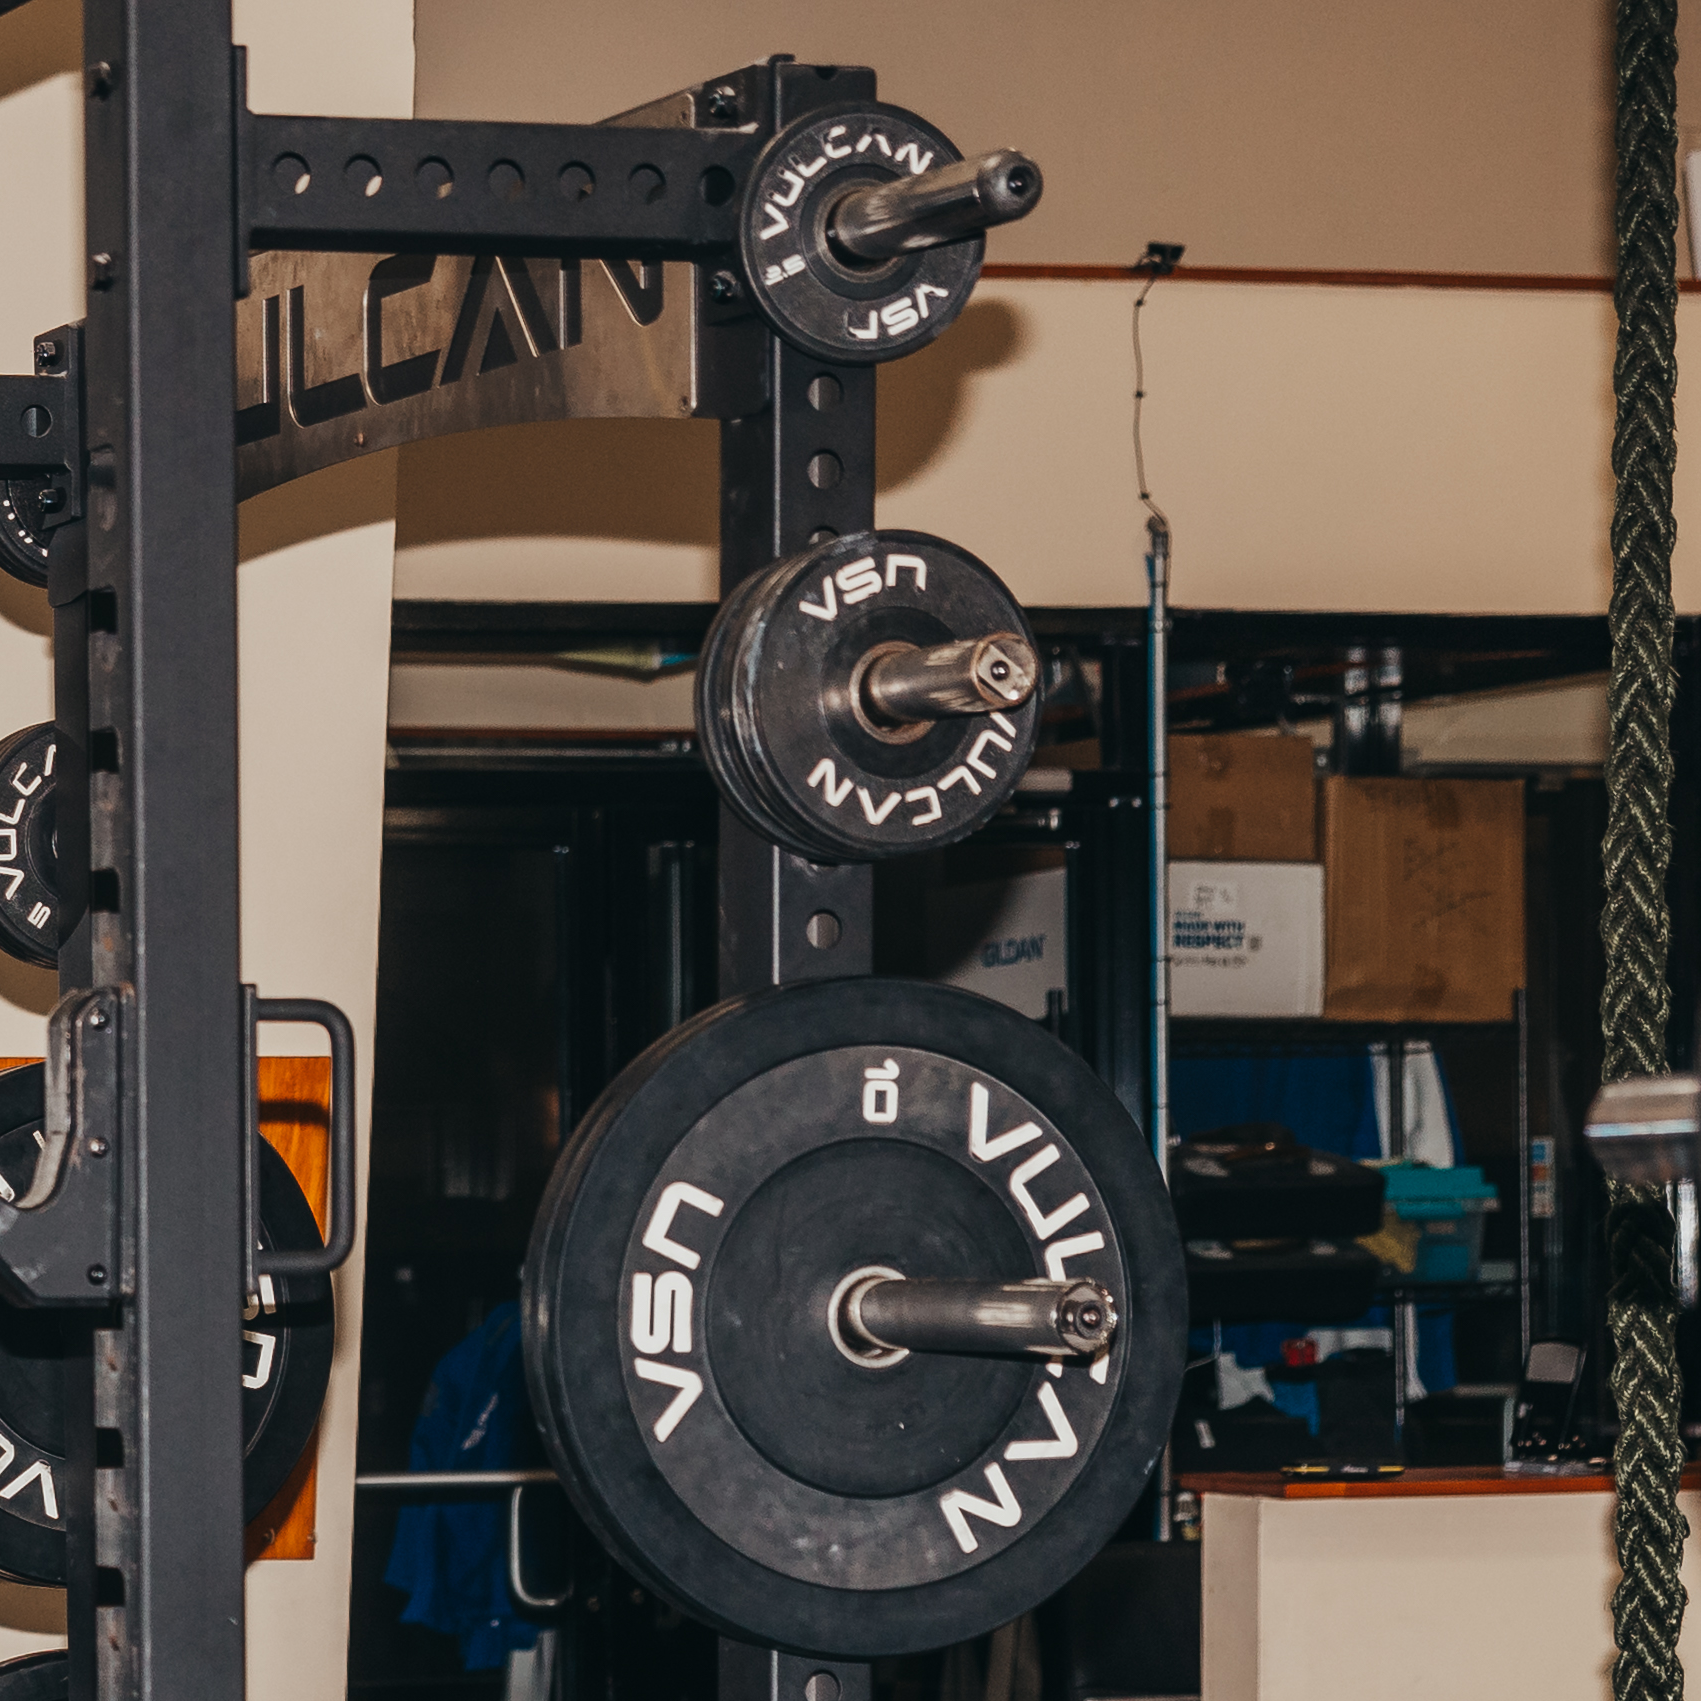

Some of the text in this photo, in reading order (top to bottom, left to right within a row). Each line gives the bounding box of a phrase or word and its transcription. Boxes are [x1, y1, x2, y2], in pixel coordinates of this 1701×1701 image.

[759, 125, 934, 241] VULCAN
[236, 254, 664, 447] LCAN
[845, 283, 949, 340] USA
[799, 553, 927, 622] USA
[862, 1057, 900, 1124] 10
[630, 1181, 725, 1442] USA
[938, 1081, 1108, 1554] VULAN
